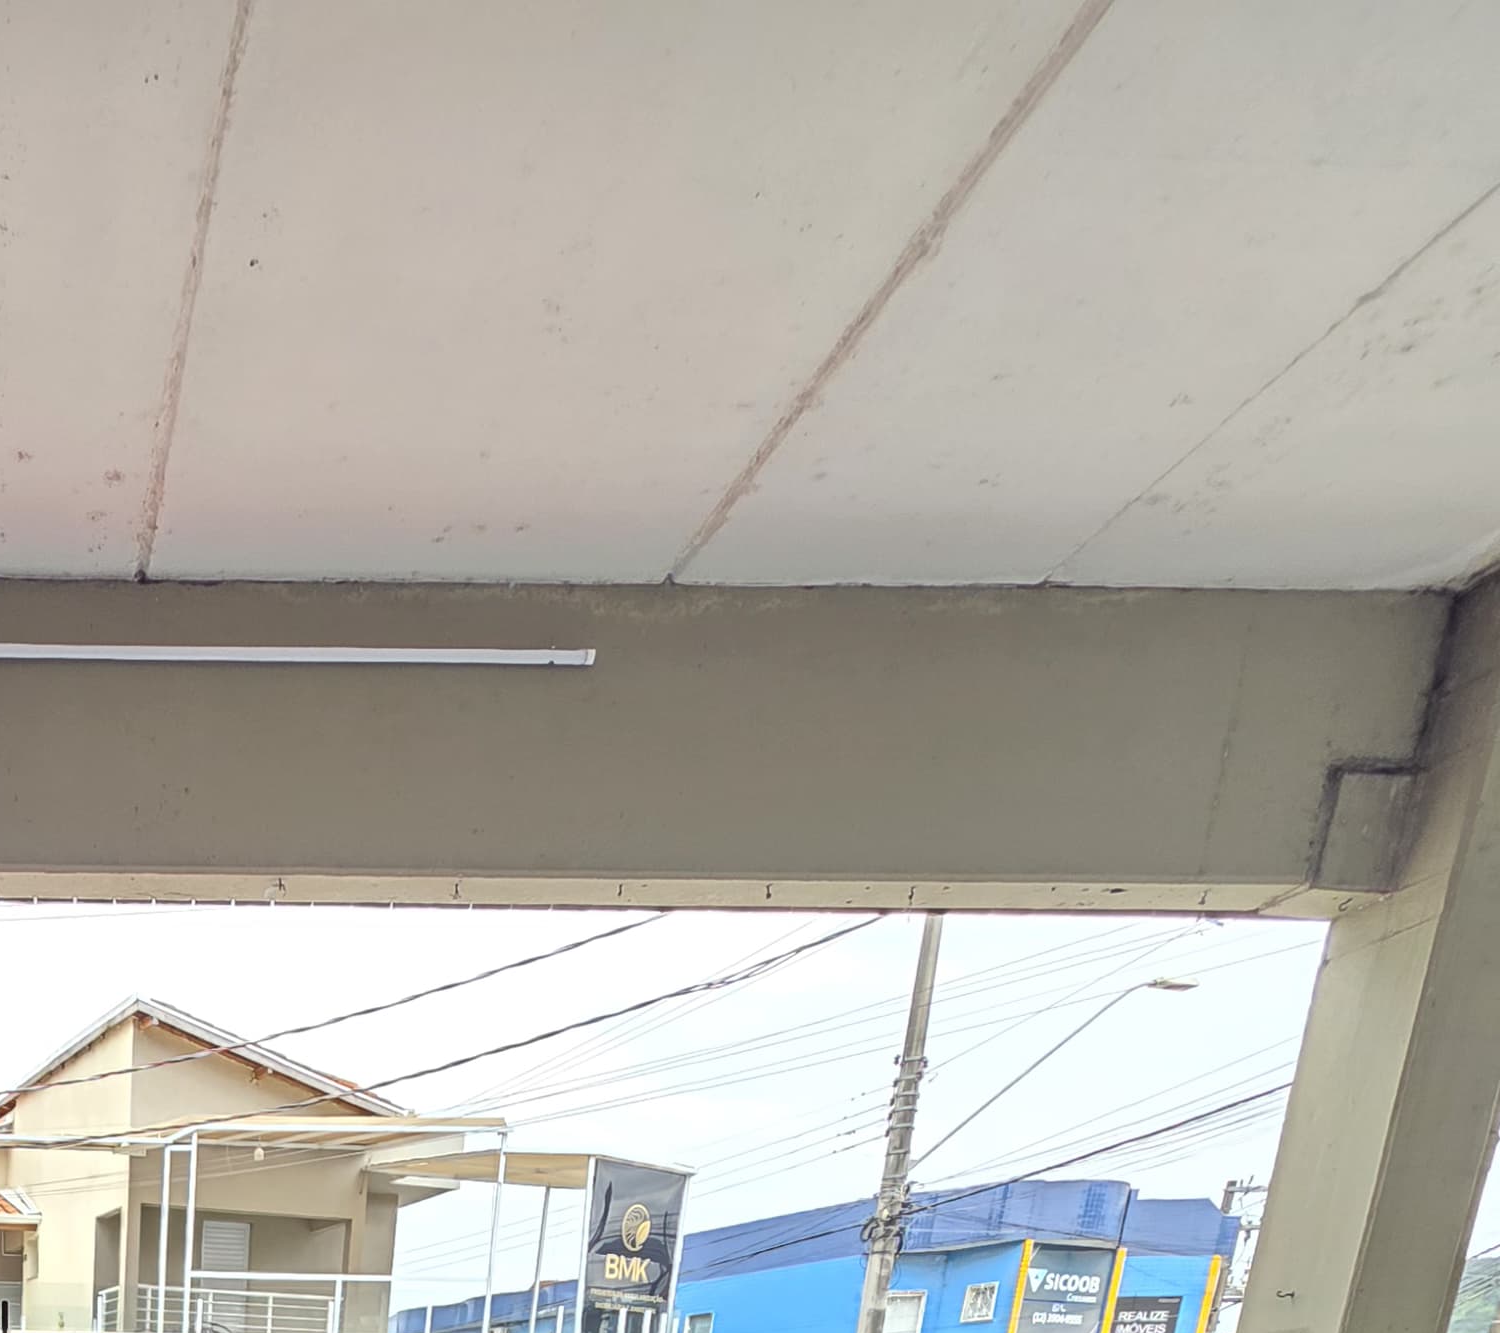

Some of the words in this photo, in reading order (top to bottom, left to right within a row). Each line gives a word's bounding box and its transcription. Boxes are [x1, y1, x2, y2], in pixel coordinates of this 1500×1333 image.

[605, 1254, 651, 1283] BMK
[1044, 1272, 1100, 1293] SICOOB
[1117, 1310, 1170, 1322] REALIZE
